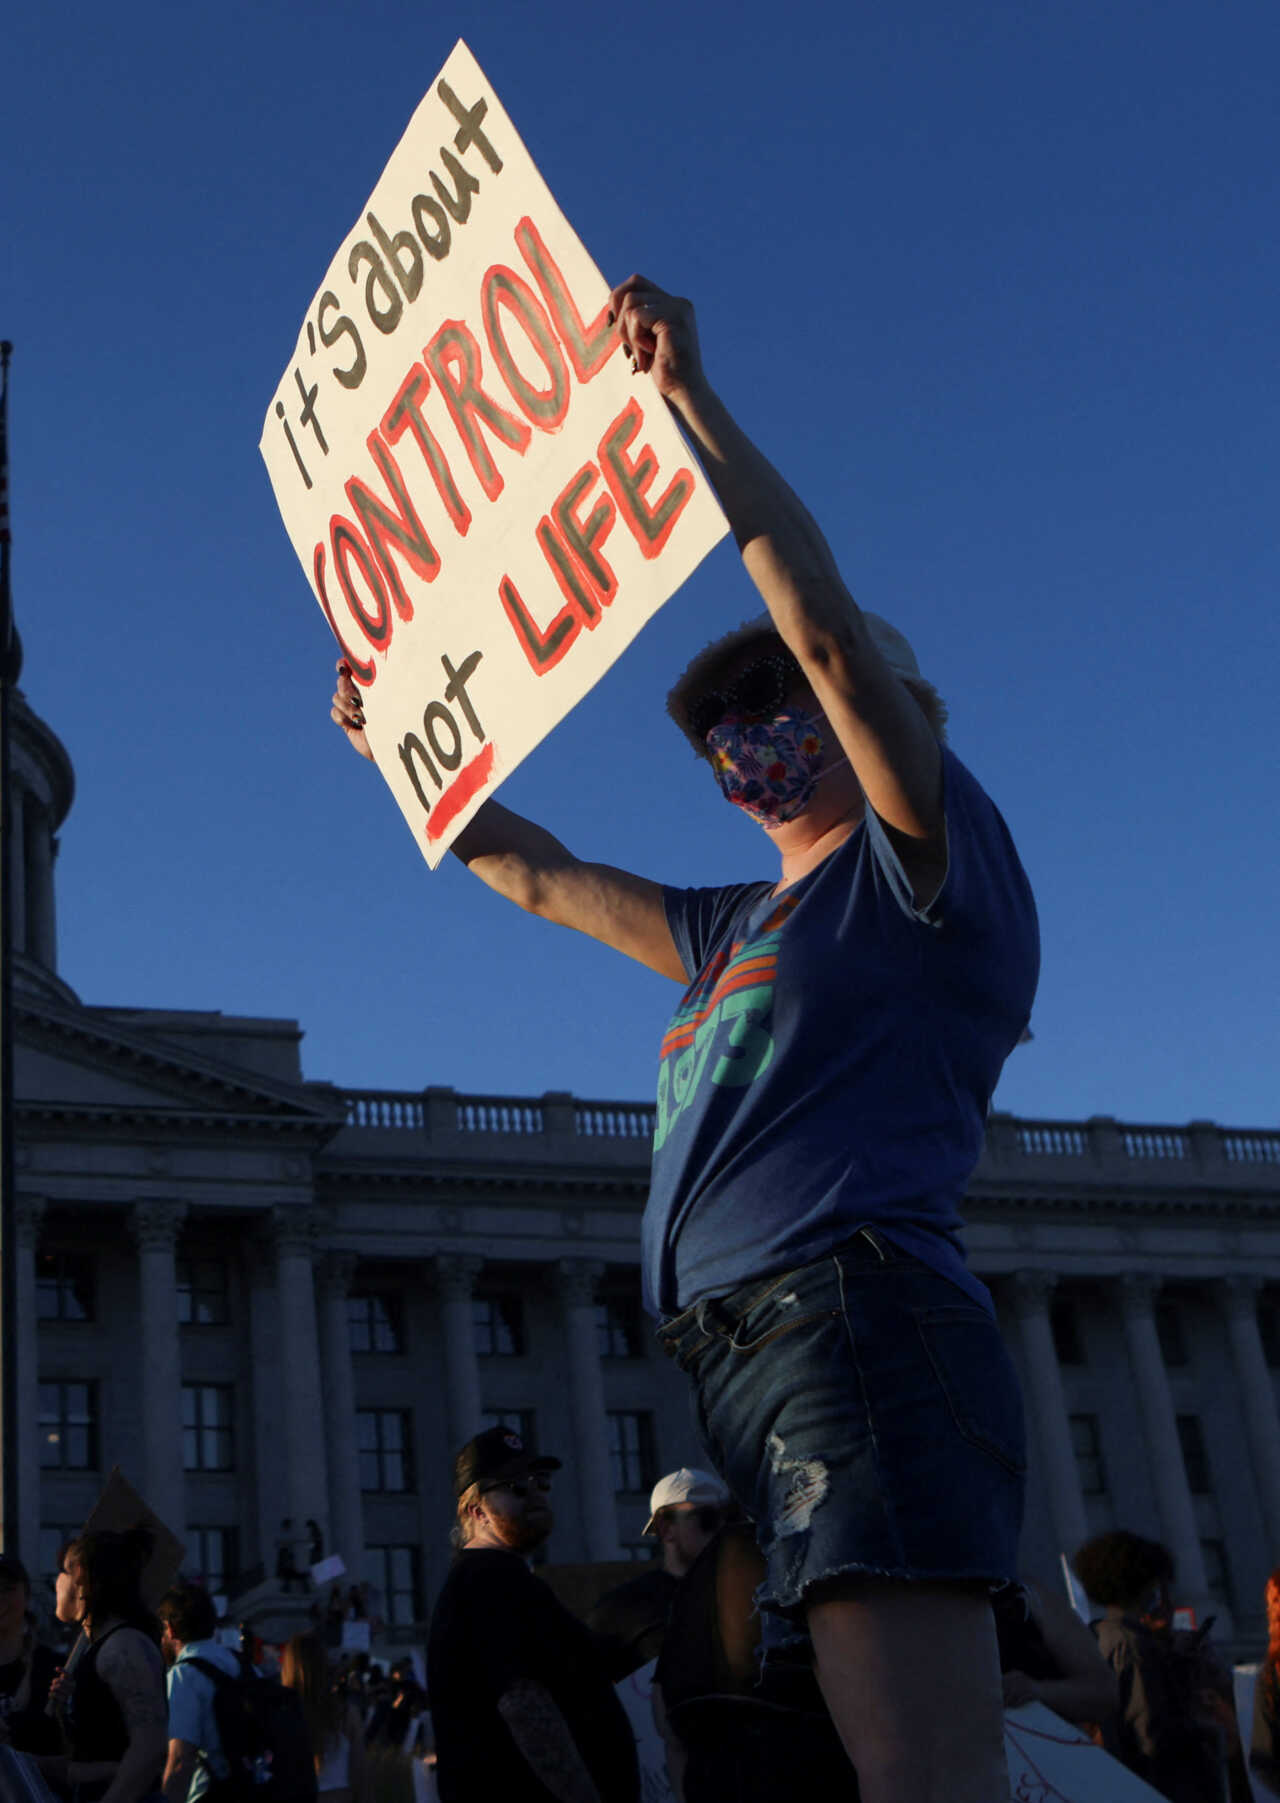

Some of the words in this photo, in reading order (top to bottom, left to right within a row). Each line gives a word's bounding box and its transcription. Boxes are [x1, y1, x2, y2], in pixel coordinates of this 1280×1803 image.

[276, 290, 368, 490] it's
[347, 78, 504, 336] about
[314, 216, 623, 688] CONTROL
[398, 650, 485, 814] not
[498, 396, 696, 677] LIFE
